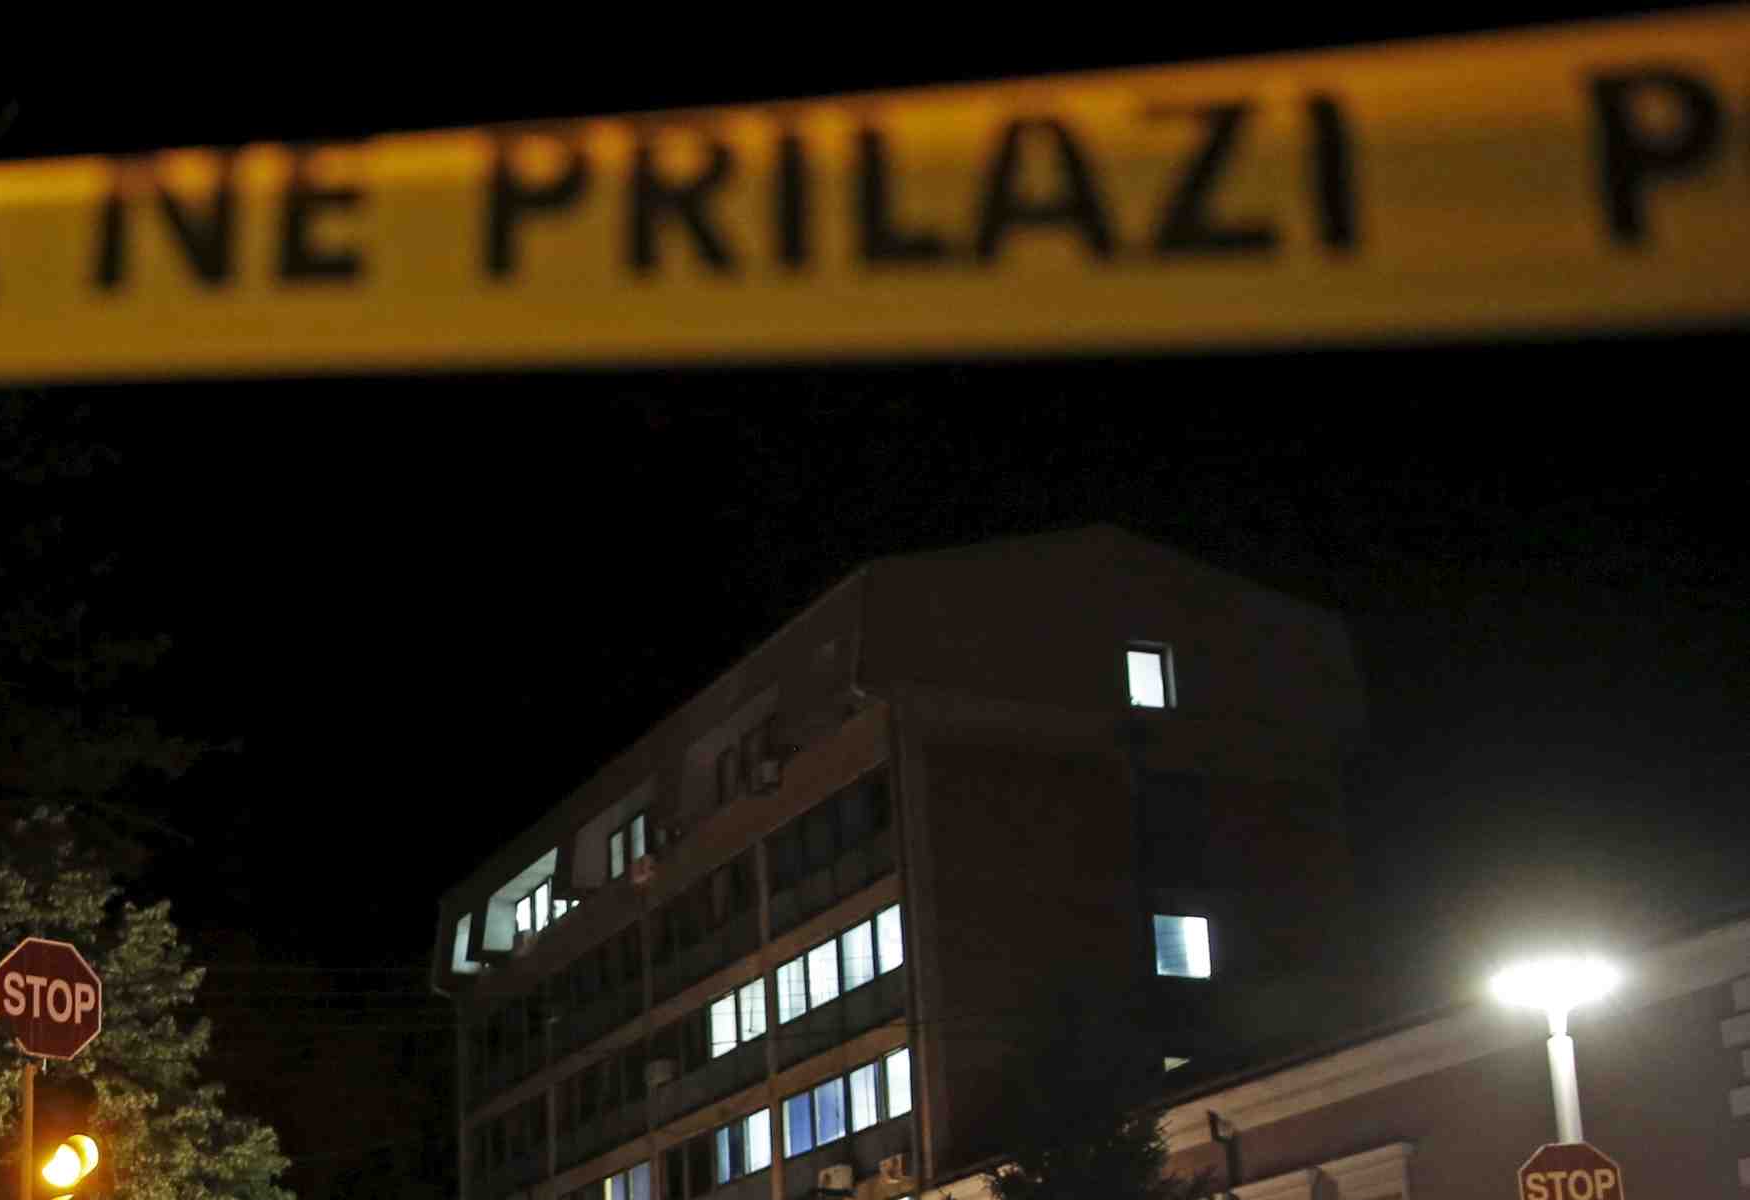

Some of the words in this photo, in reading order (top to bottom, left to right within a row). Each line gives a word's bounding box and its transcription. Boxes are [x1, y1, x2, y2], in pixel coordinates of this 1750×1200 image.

[92, 146, 365, 292] NE
[482, 92, 1358, 282] PRILAZI
[3, 971, 96, 1025] STOP
